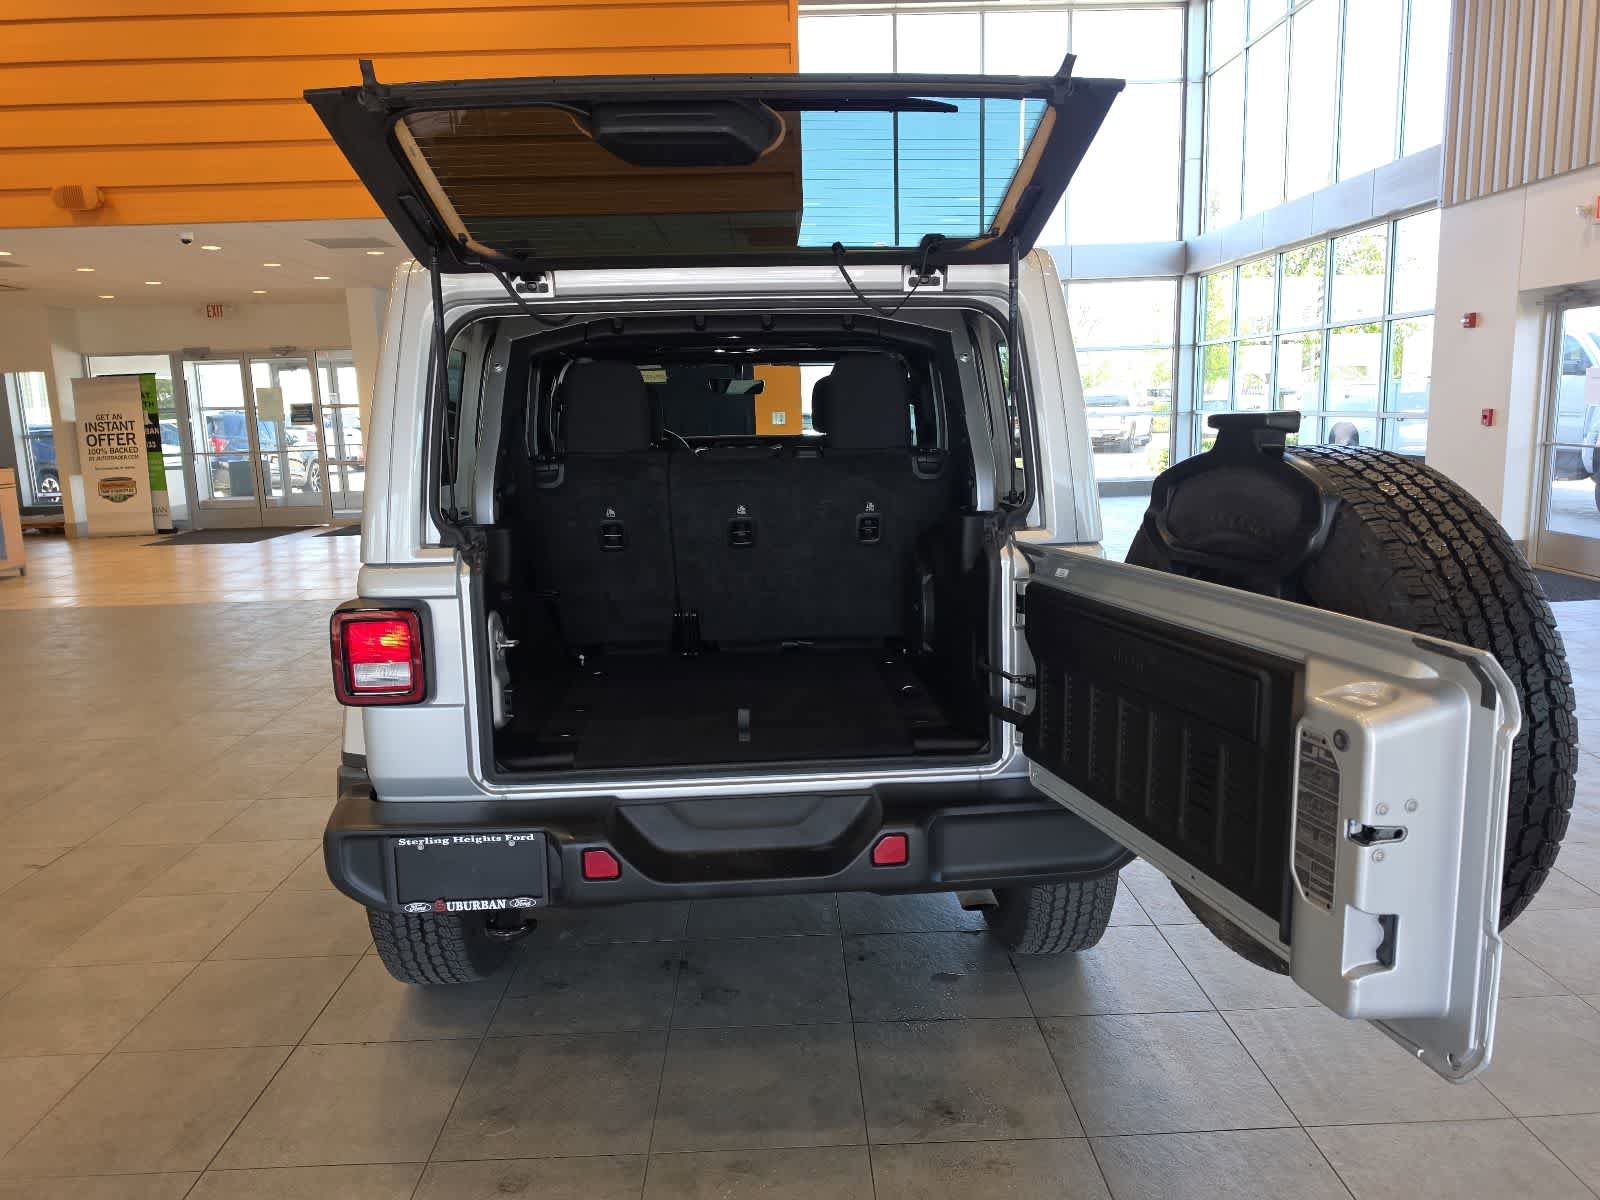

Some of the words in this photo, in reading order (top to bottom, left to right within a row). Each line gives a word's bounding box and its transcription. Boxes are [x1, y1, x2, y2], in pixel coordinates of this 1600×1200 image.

[207, 304, 224, 318] EXIT
[112, 413, 123, 421] AN
[84, 421, 136, 432] INSTANT
[86, 433, 137, 447] OFFER
[88, 448, 107, 456] 100%
[110, 447, 139, 455] BACKED
[398, 837, 450, 847] Sterling
[453, 835, 502, 844] Heights
[505, 833, 535, 841] Ford
[407, 903, 429, 912] Ford
[434, 899, 507, 912] SUBURBAN
[512, 897, 534, 907] Ford
